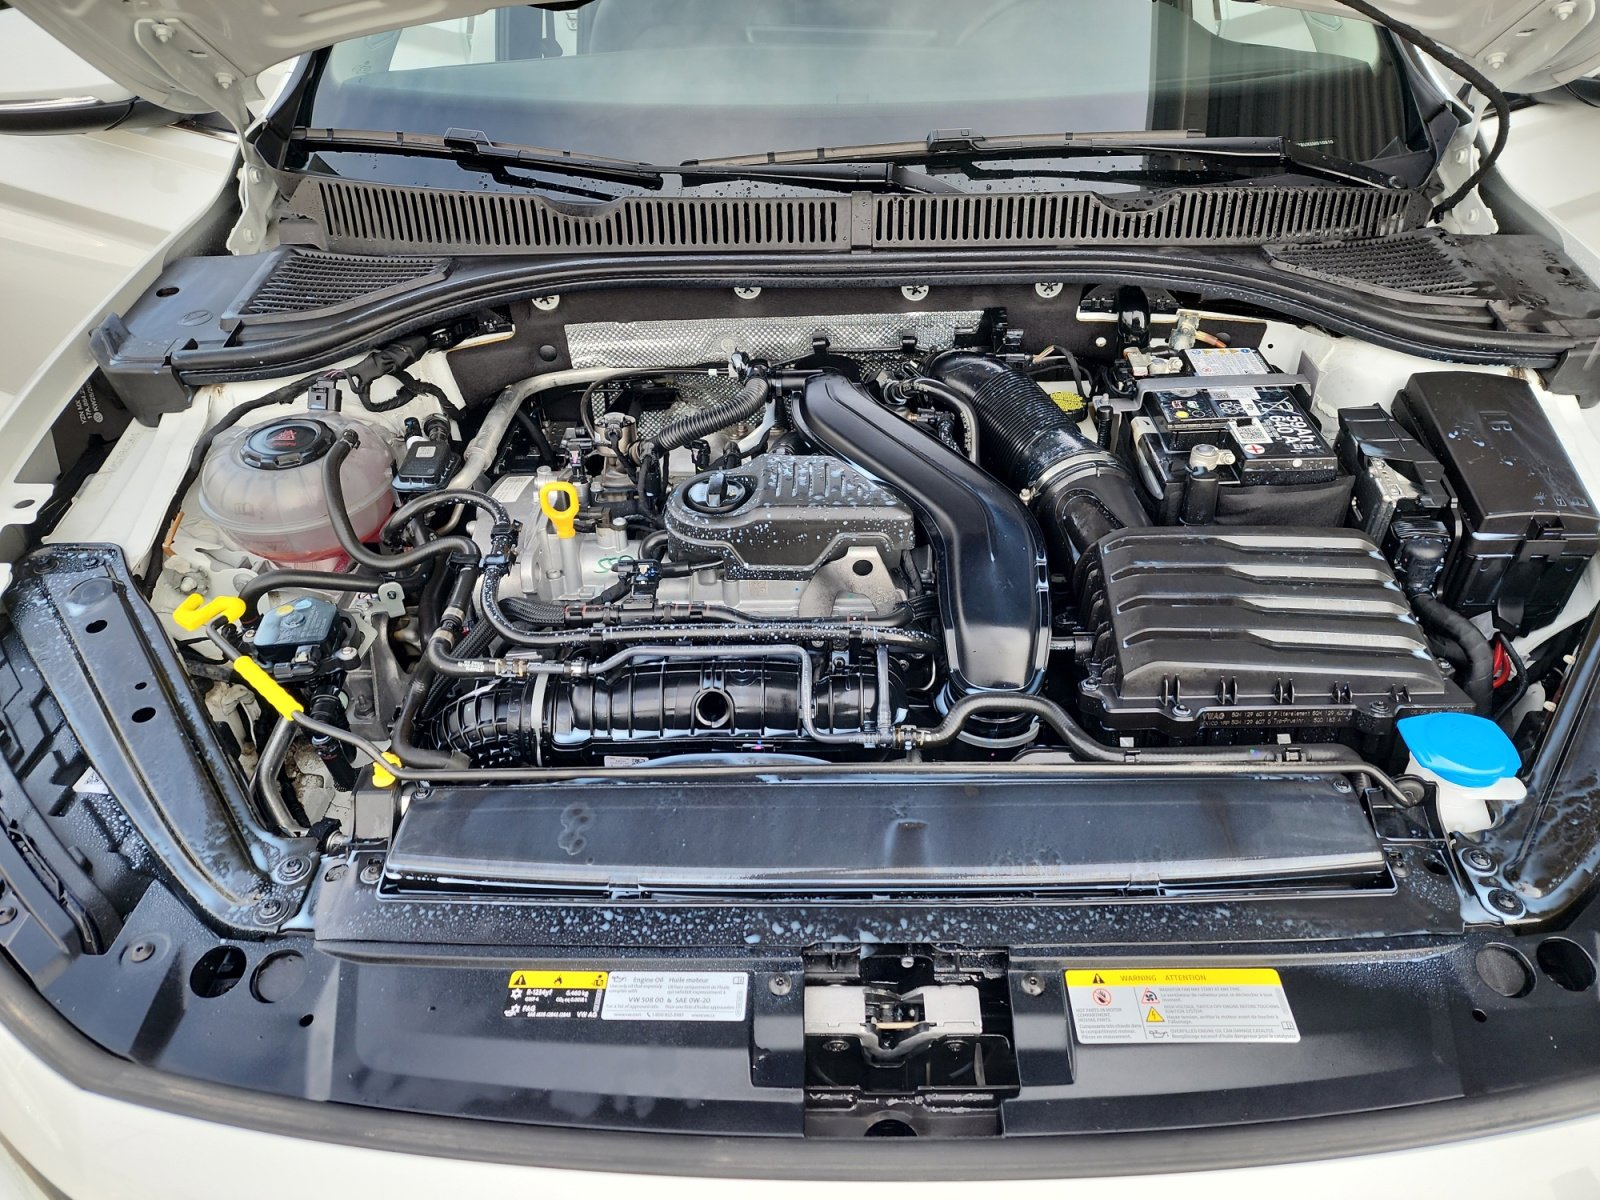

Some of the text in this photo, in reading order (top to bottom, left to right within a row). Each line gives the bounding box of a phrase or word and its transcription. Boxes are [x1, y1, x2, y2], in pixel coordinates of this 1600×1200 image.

[1269, 415, 1294, 434] 640
[1286, 415, 1316, 442] 59Ah
[1281, 435, 1301, 443] A
[633, 976, 654, 984] Engine
[1120, 974, 1157, 982] WARNING
